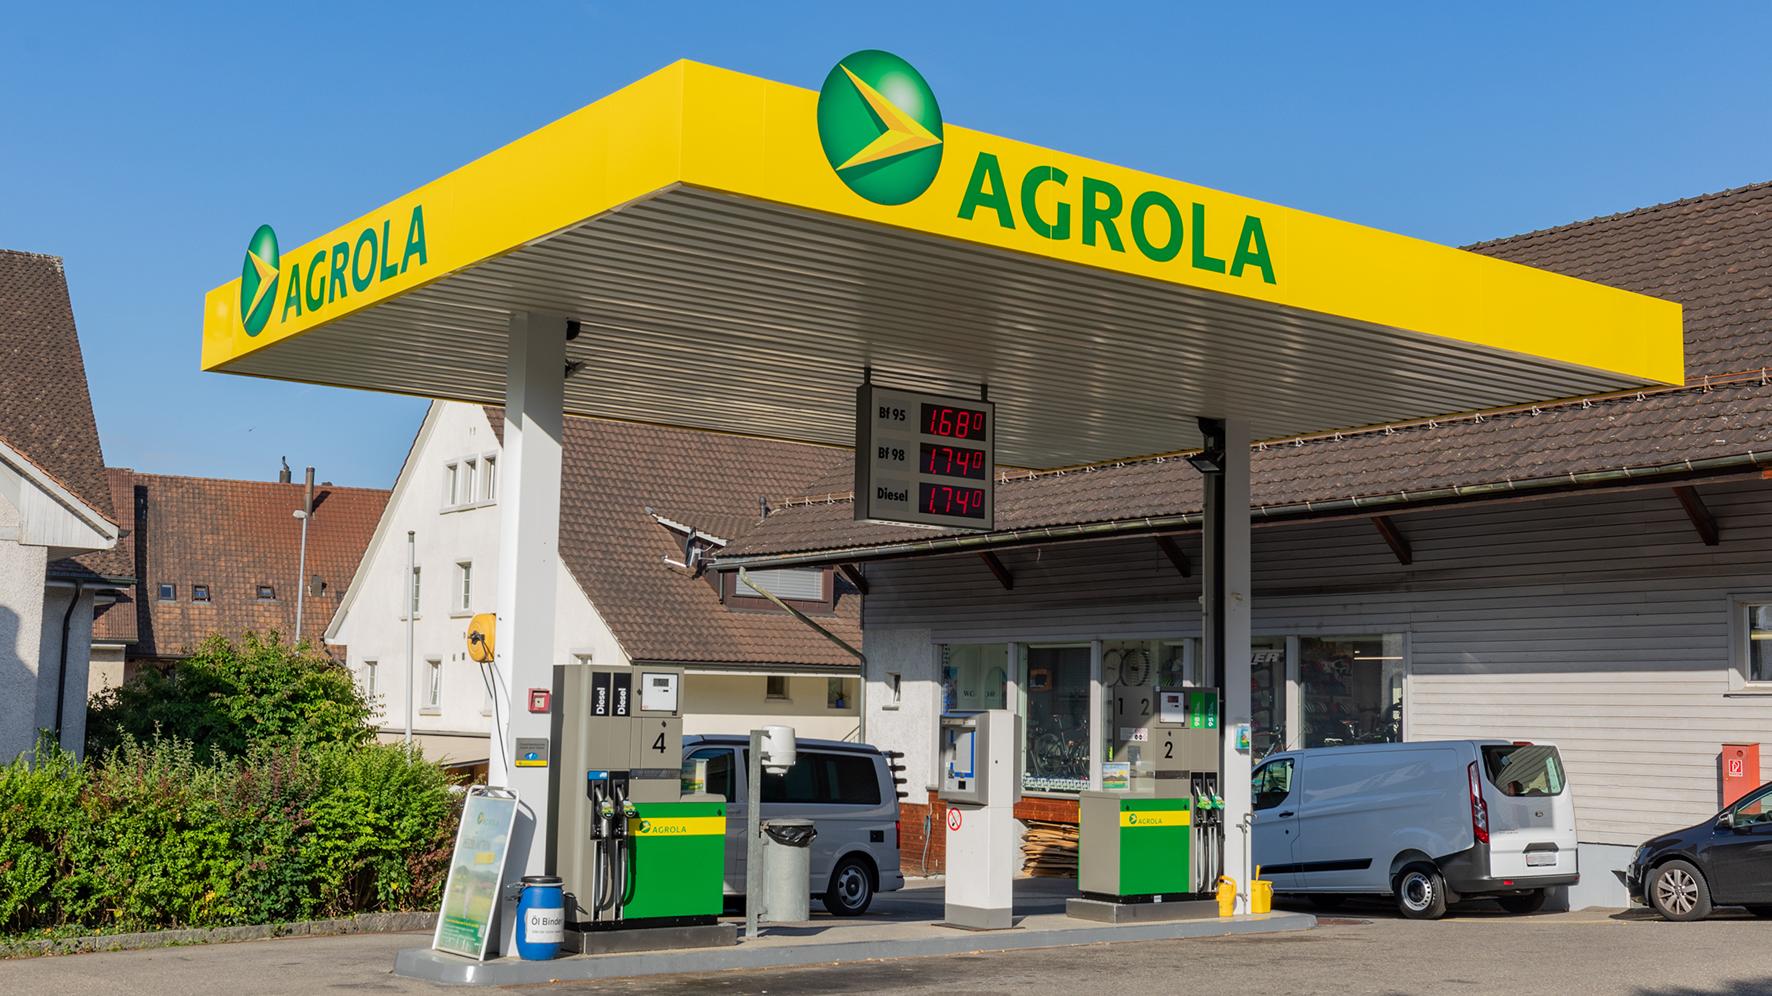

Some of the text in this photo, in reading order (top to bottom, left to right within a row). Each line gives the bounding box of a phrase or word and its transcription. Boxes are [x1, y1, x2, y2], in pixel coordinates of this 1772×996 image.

[957, 151, 1277, 285] AGROLA
[280, 204, 428, 324] AGROLA
[879, 406, 906, 421] Bf 95
[878, 446, 905, 462] Bf 98
[877, 487, 908, 502] Diesel
[596, 687, 606, 715] Diesel
[617, 688, 627, 715] Diesel
[1118, 697, 1124, 715] 1
[1140, 697, 1150, 716] 2
[1207, 716, 1214, 727] 95
[652, 732, 666, 754] 4
[1164, 741, 1173, 759] 2
[652, 825, 687, 834] AGROLA
[531, 914, 541, 926] Öl
